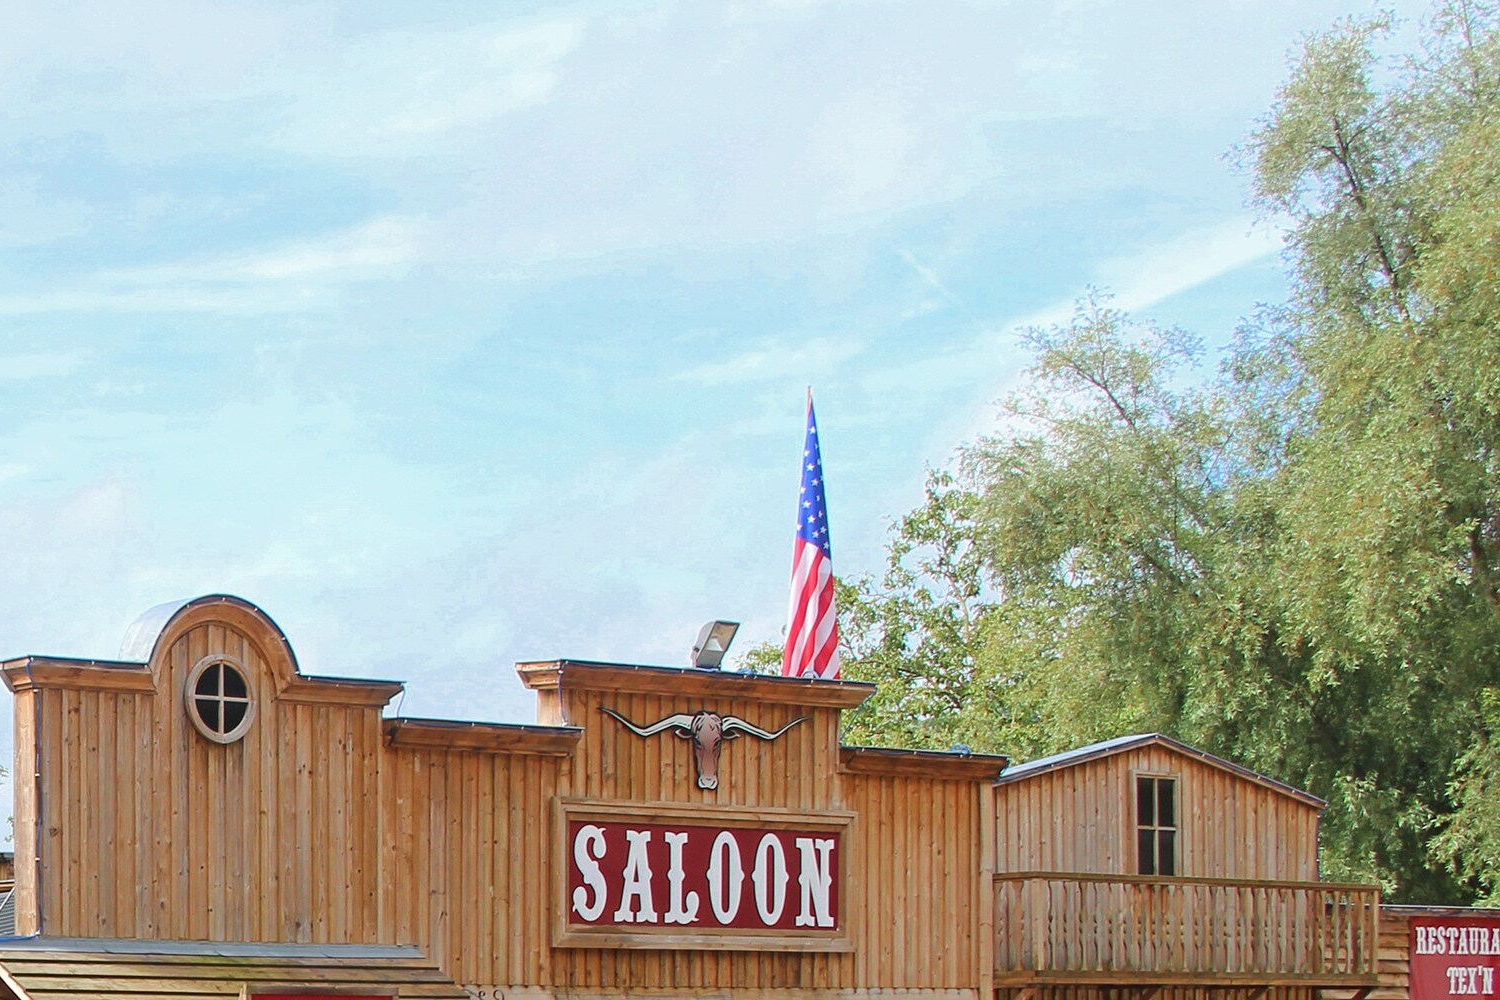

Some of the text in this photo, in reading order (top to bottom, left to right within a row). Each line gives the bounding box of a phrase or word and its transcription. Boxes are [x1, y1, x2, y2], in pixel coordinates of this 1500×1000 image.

[572, 824, 835, 927] SALOON
[1415, 926, 1500, 955] RESTAURA
[1446, 965, 1494, 995] TEX'N
